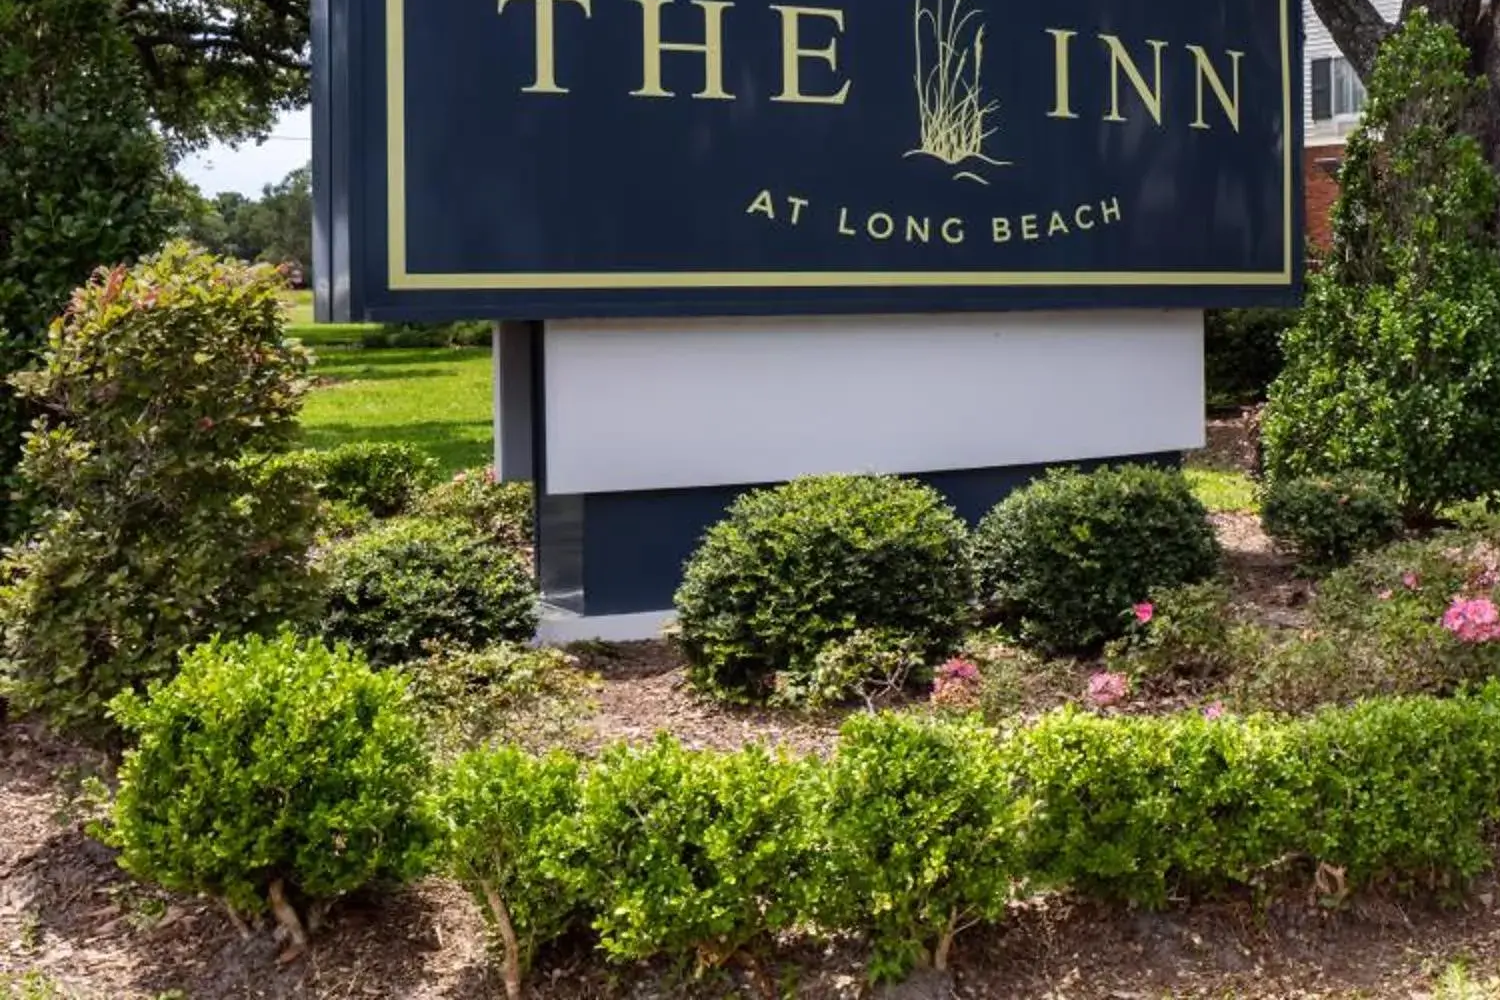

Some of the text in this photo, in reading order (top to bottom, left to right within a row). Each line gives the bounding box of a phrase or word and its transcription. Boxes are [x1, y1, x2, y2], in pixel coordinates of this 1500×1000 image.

[1044, 28, 1245, 134] INN
[746, 189, 1122, 245] AT LONG BEACH
